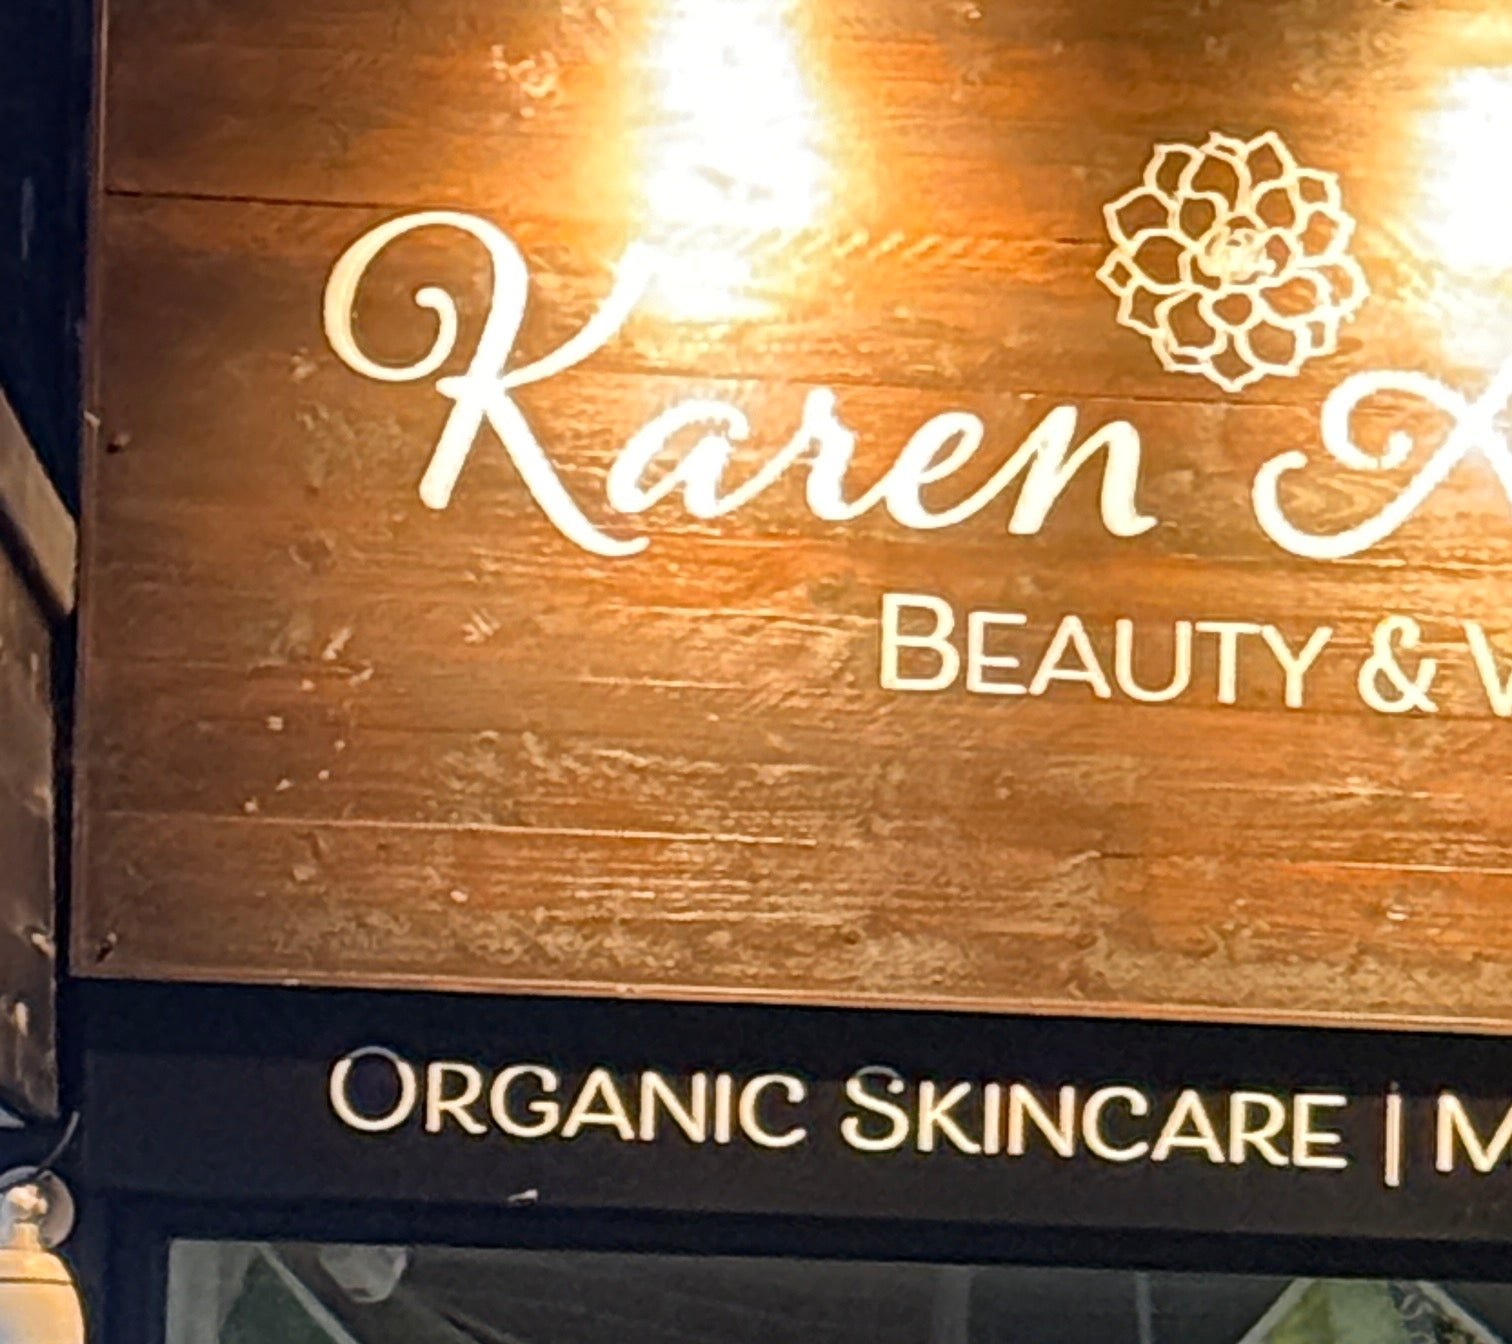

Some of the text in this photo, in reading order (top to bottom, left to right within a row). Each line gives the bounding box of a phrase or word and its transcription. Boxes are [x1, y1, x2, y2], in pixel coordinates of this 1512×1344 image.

[323, 209, 1158, 556] Karen
[878, 591, 1331, 708] BEAUTY
[1358, 614, 1438, 714] &
[328, 1044, 808, 1149] ORGANIC
[840, 1065, 1349, 1169] SKINCARE
